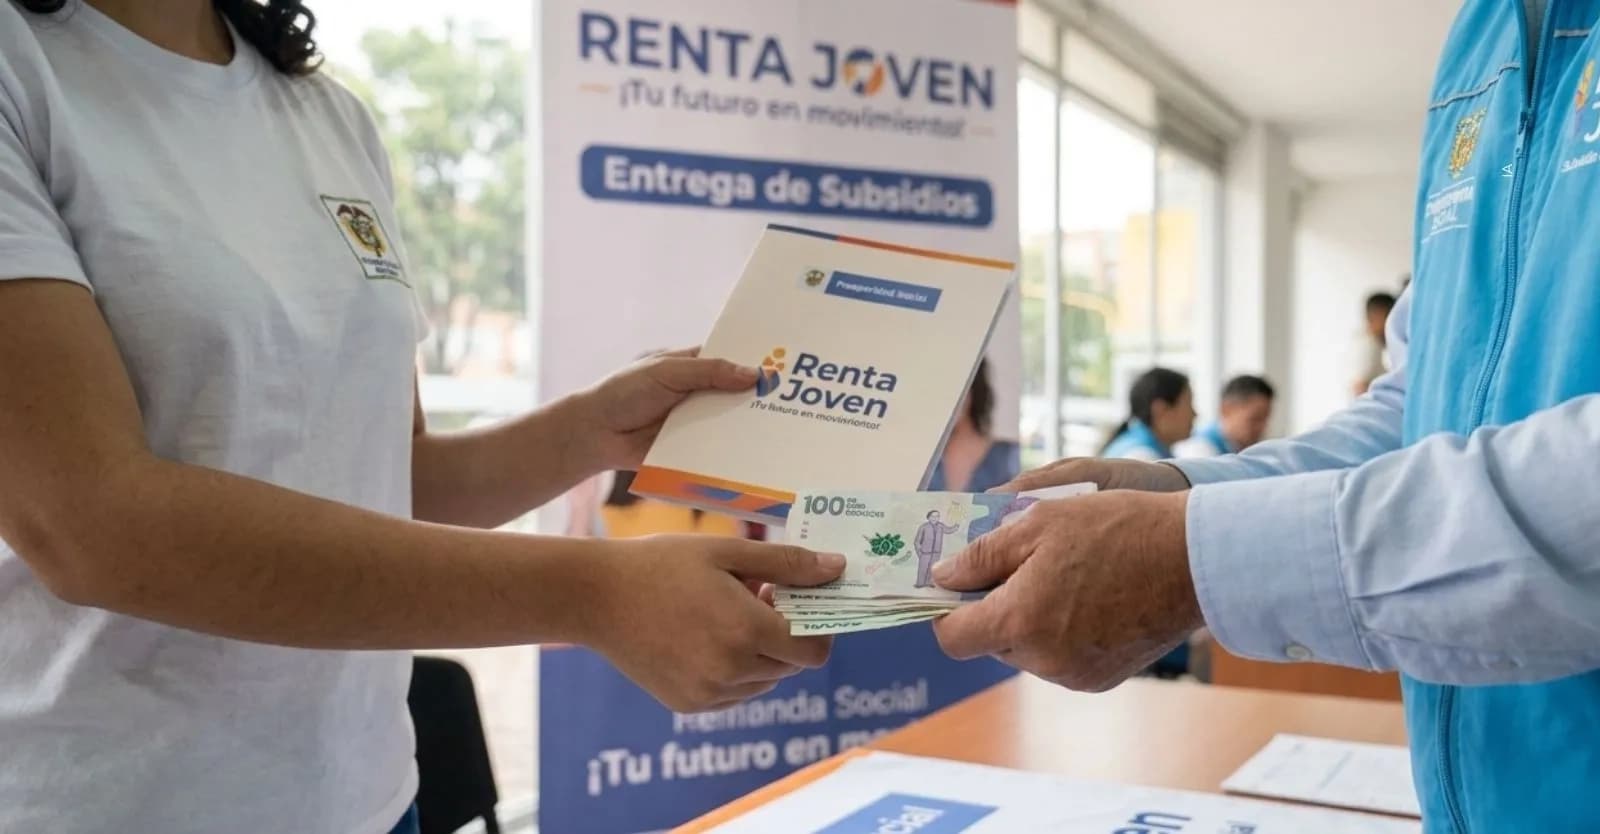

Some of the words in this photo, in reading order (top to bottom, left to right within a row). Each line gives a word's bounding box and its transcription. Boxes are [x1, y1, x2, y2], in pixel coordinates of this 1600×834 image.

[580, 11, 792, 84] RENTA
[810, 43, 995, 109] JOVEN
[673, 84, 759, 116] futuro
[766, 101, 800, 122] en
[604, 155, 755, 207] Entrega
[763, 169, 810, 205] de
[818, 174, 979, 219] Subsidios
[791, 352, 897, 392] Renta
[779, 379, 888, 418] Joven
[803, 495, 845, 516] 100
[834, 681, 927, 719] Social
[587, 748, 651, 797] ¡Tu
[660, 739, 777, 779] futuro
[784, 734, 830, 765] en
